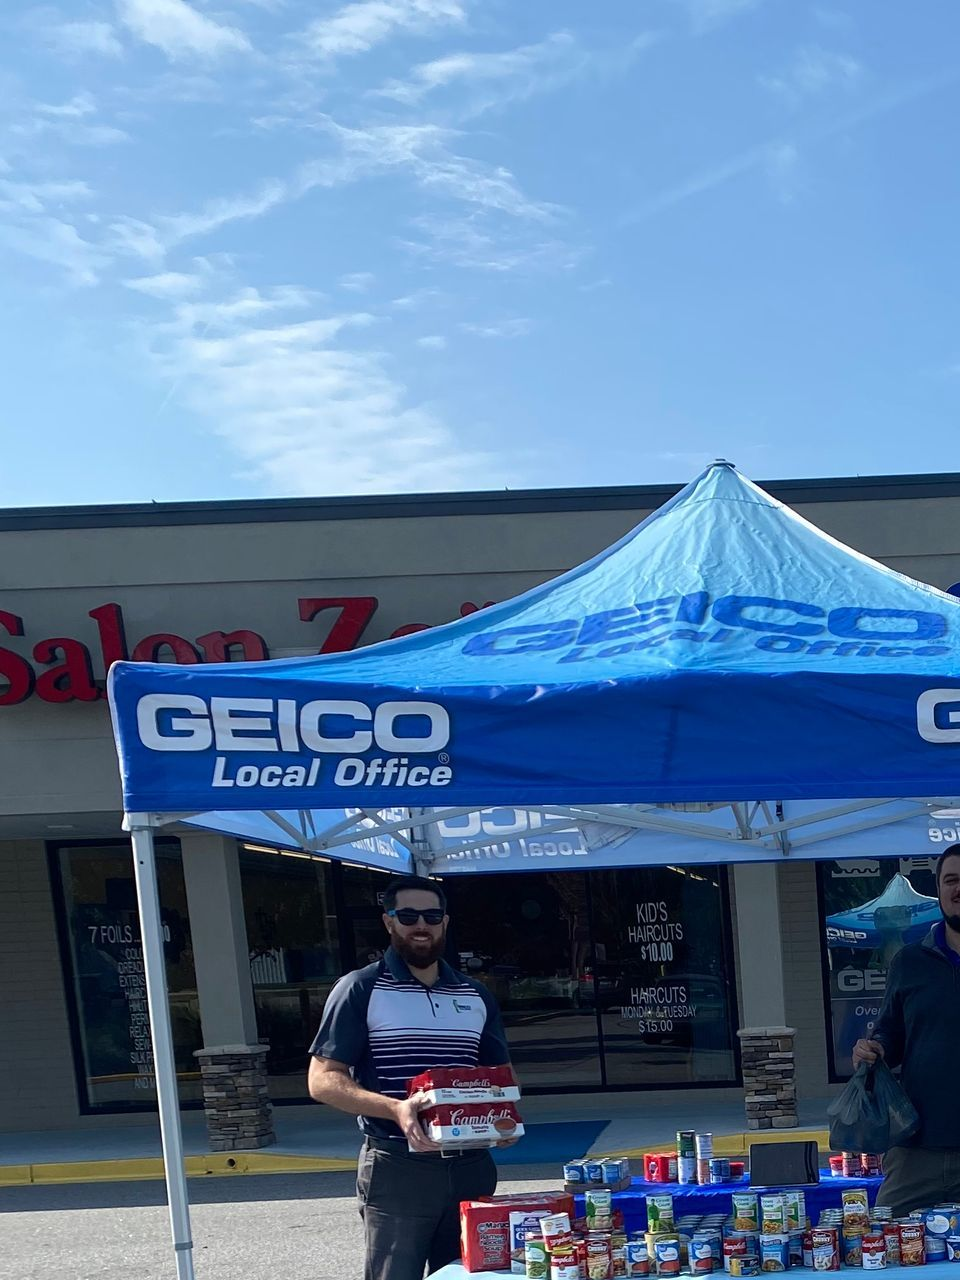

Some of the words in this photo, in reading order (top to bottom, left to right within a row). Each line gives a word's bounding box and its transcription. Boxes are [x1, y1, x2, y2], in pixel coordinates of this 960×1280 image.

[462, 592, 948, 656] GEICO
[0, 602, 268, 705] Salon
[557, 625, 737, 664] Local
[755, 635, 951, 658] Office
[137, 694, 450, 753] GEICO
[211, 757, 320, 788] Local
[334, 757, 452, 787] Office
[636, 902, 668, 923] KID'S
[88, 926, 98, 943] 7
[628, 923, 683, 943] HAIRCUTS
[641, 942, 673, 961] $10.00
[118, 961, 145, 974] DREAD
[631, 986, 686, 1004] HAIRCUTS
[621, 1005, 652, 1018] MONDAY
[663, 1005, 697, 1018] TUESDAY
[638, 1020, 673, 1033] $15.00
